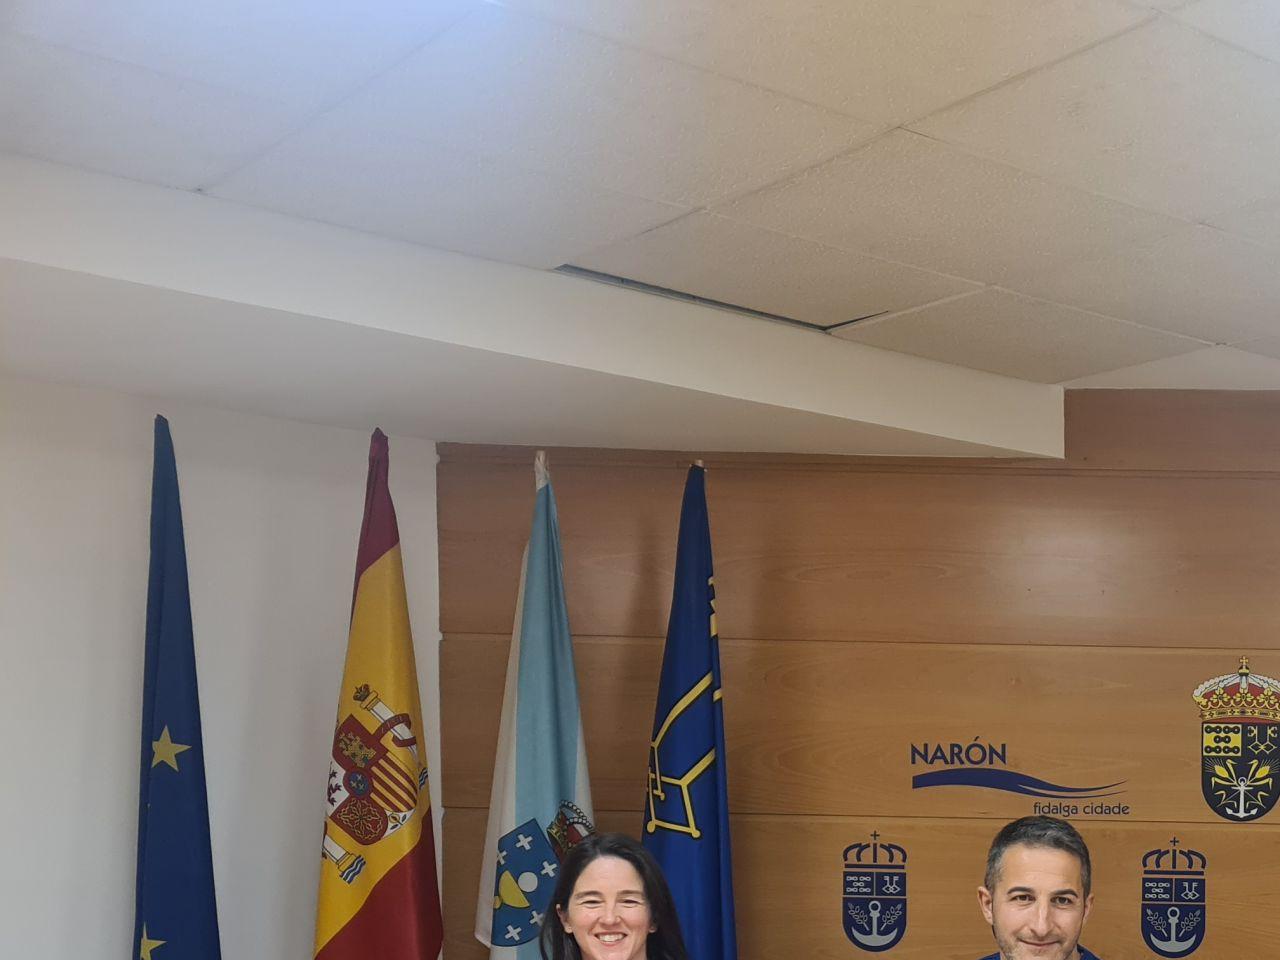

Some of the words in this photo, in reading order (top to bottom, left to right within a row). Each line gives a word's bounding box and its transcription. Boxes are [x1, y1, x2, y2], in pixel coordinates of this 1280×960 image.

[910, 736, 1007, 765] NARÓN
[1033, 802, 1078, 817] fidalga
[1083, 802, 1130, 815] cidade
